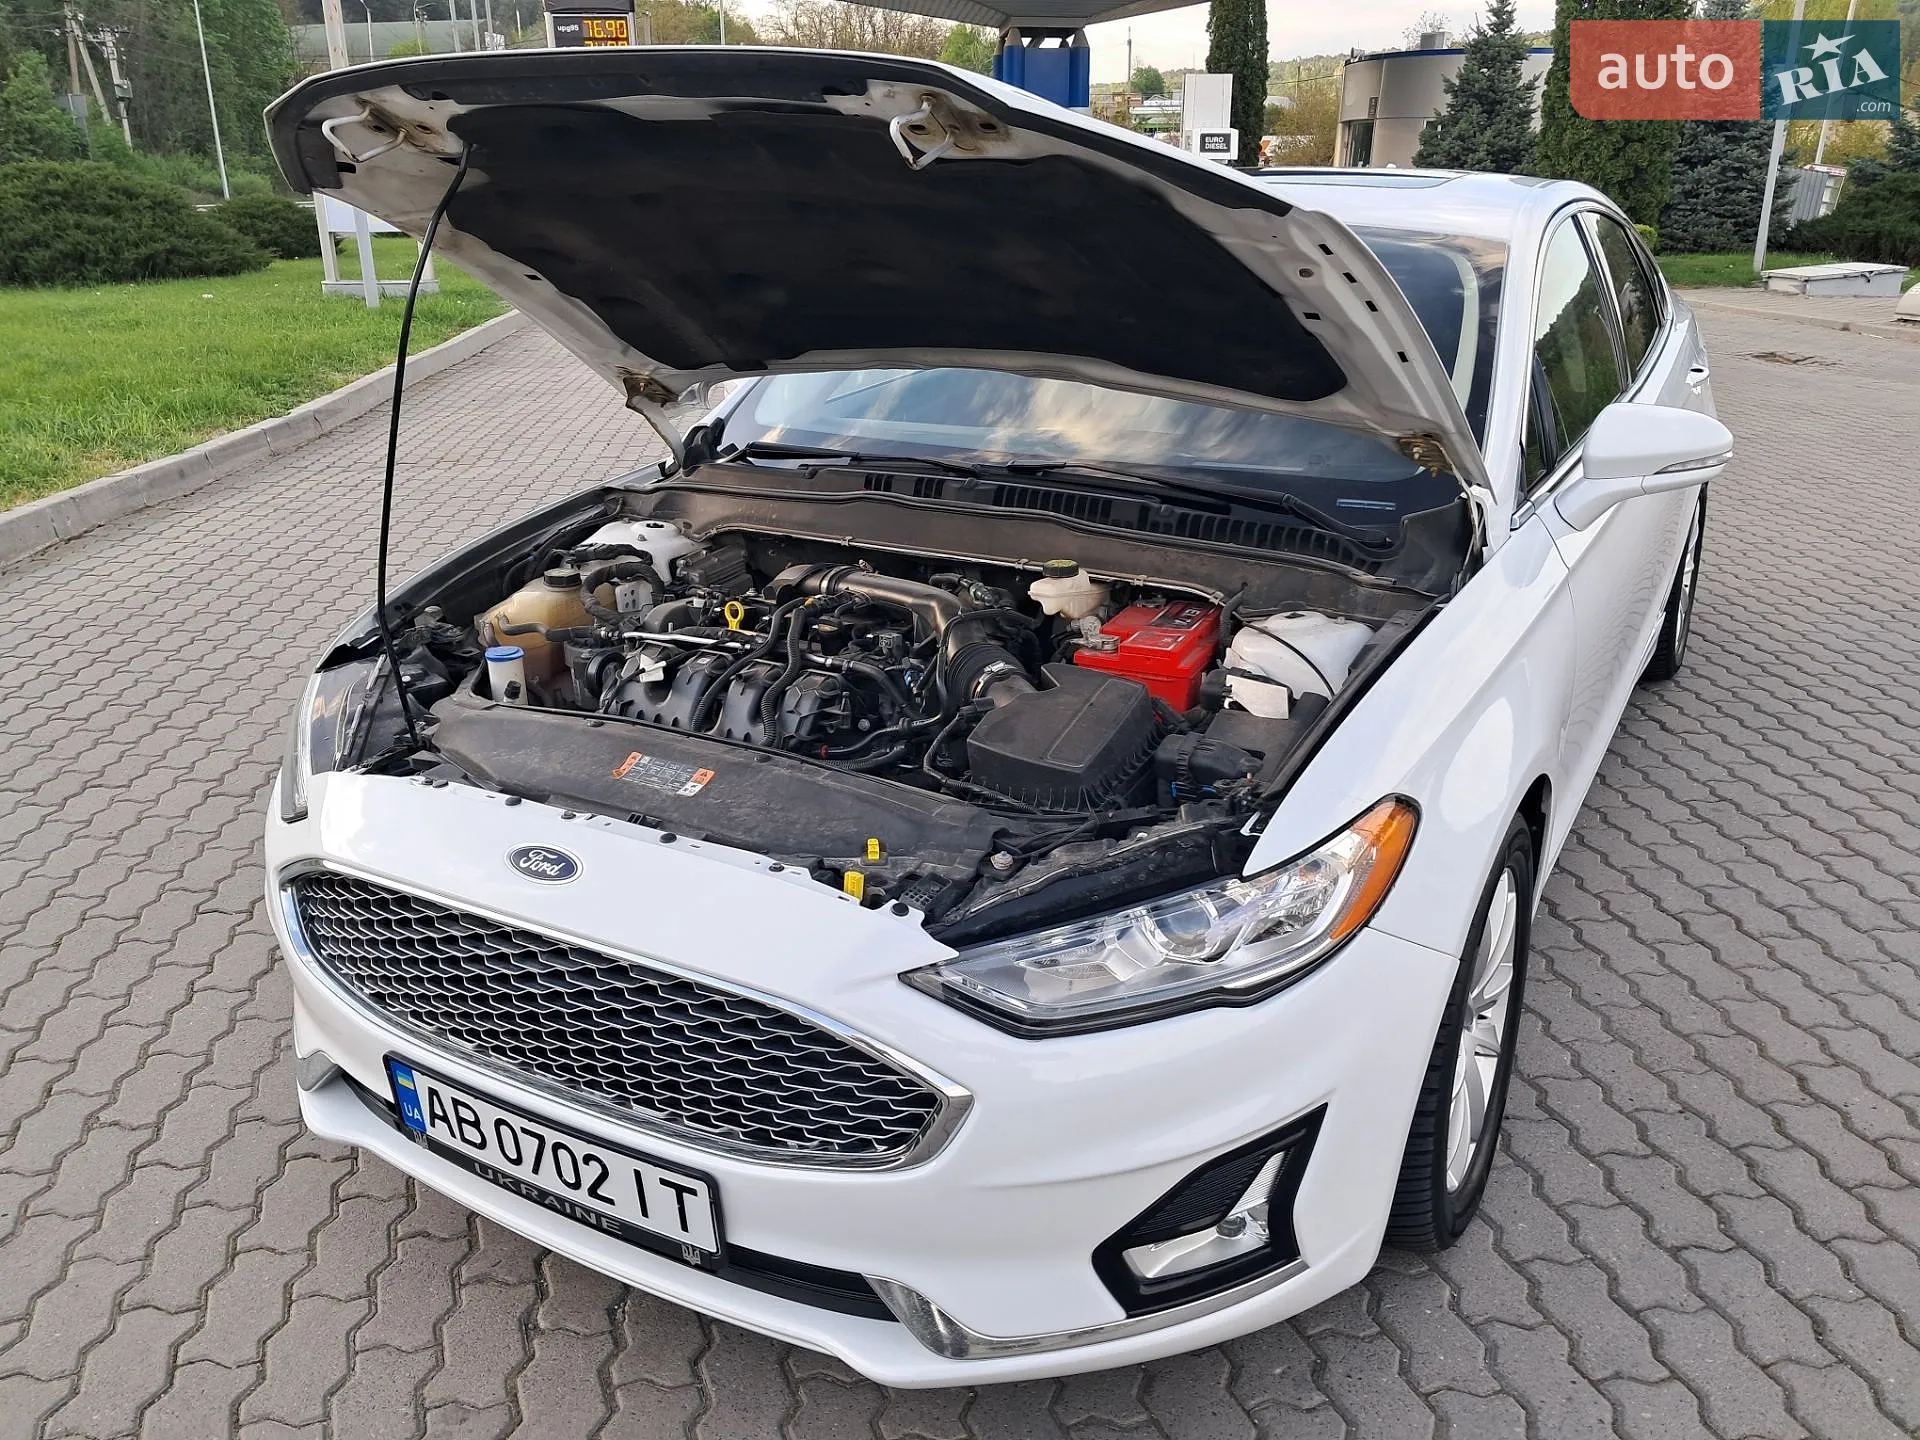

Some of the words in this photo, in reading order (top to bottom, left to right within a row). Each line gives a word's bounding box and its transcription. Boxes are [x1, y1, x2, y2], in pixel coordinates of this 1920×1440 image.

[557, 24, 579, 32] upg95
[519, 849, 566, 876] Ford
[404, 1104, 422, 1122] UA
[428, 1086, 487, 1151] AB
[493, 1117, 615, 1206] 0702
[633, 1168, 698, 1233] IT
[474, 1162, 623, 1235] UKRAINE
